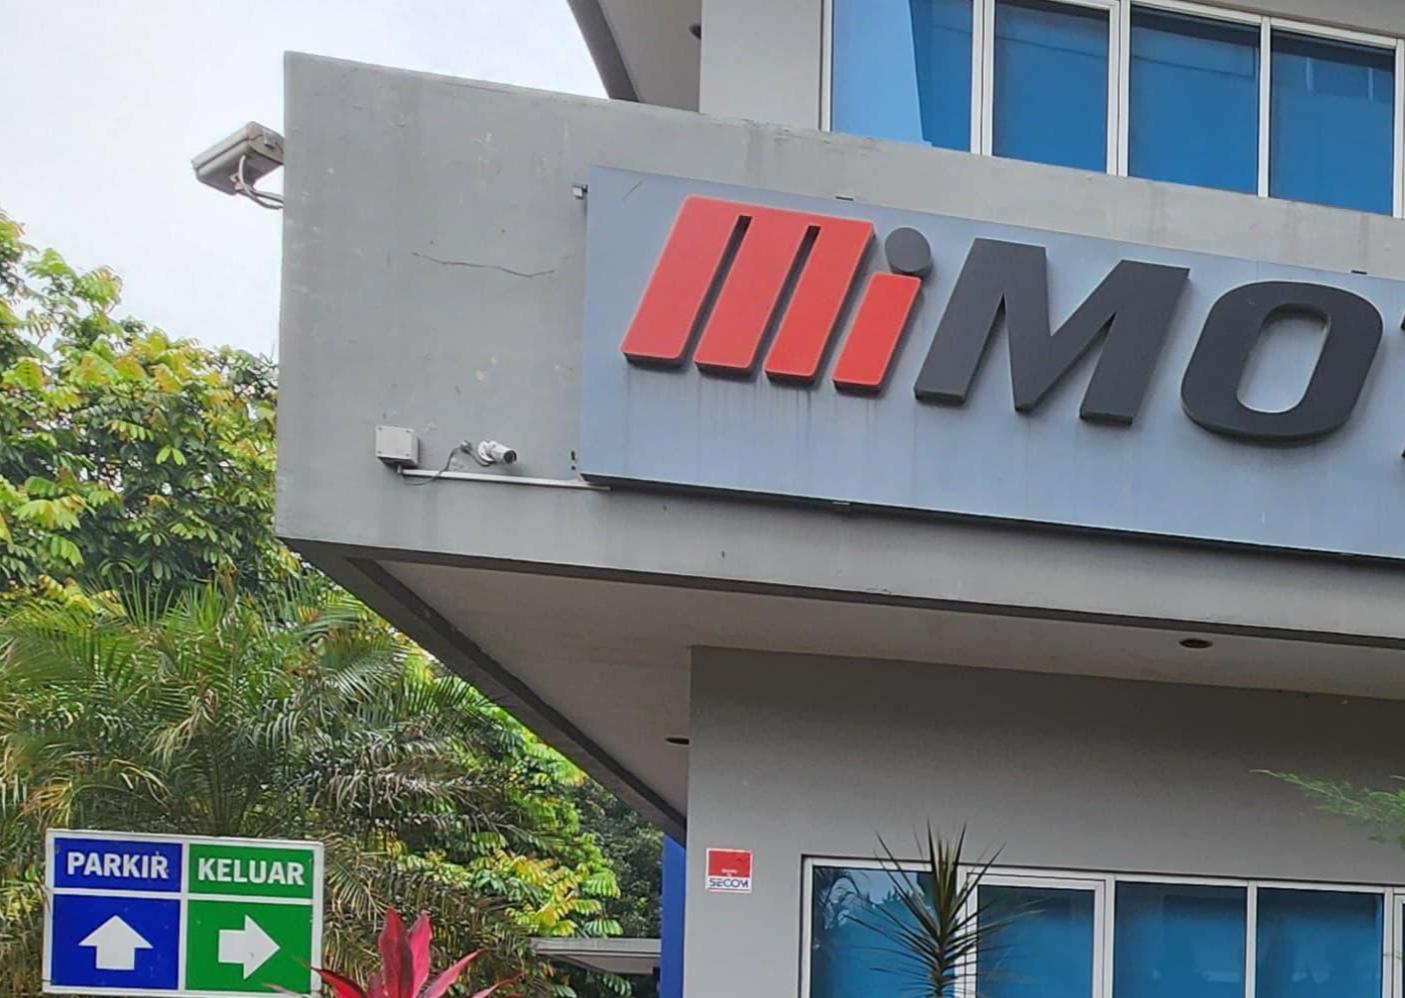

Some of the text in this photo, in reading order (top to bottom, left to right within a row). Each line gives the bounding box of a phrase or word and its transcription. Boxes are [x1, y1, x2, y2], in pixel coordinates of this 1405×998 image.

[67, 851, 168, 879] PARKIR
[198, 857, 304, 885] KELUAR
[709, 877, 749, 889] SECOM
